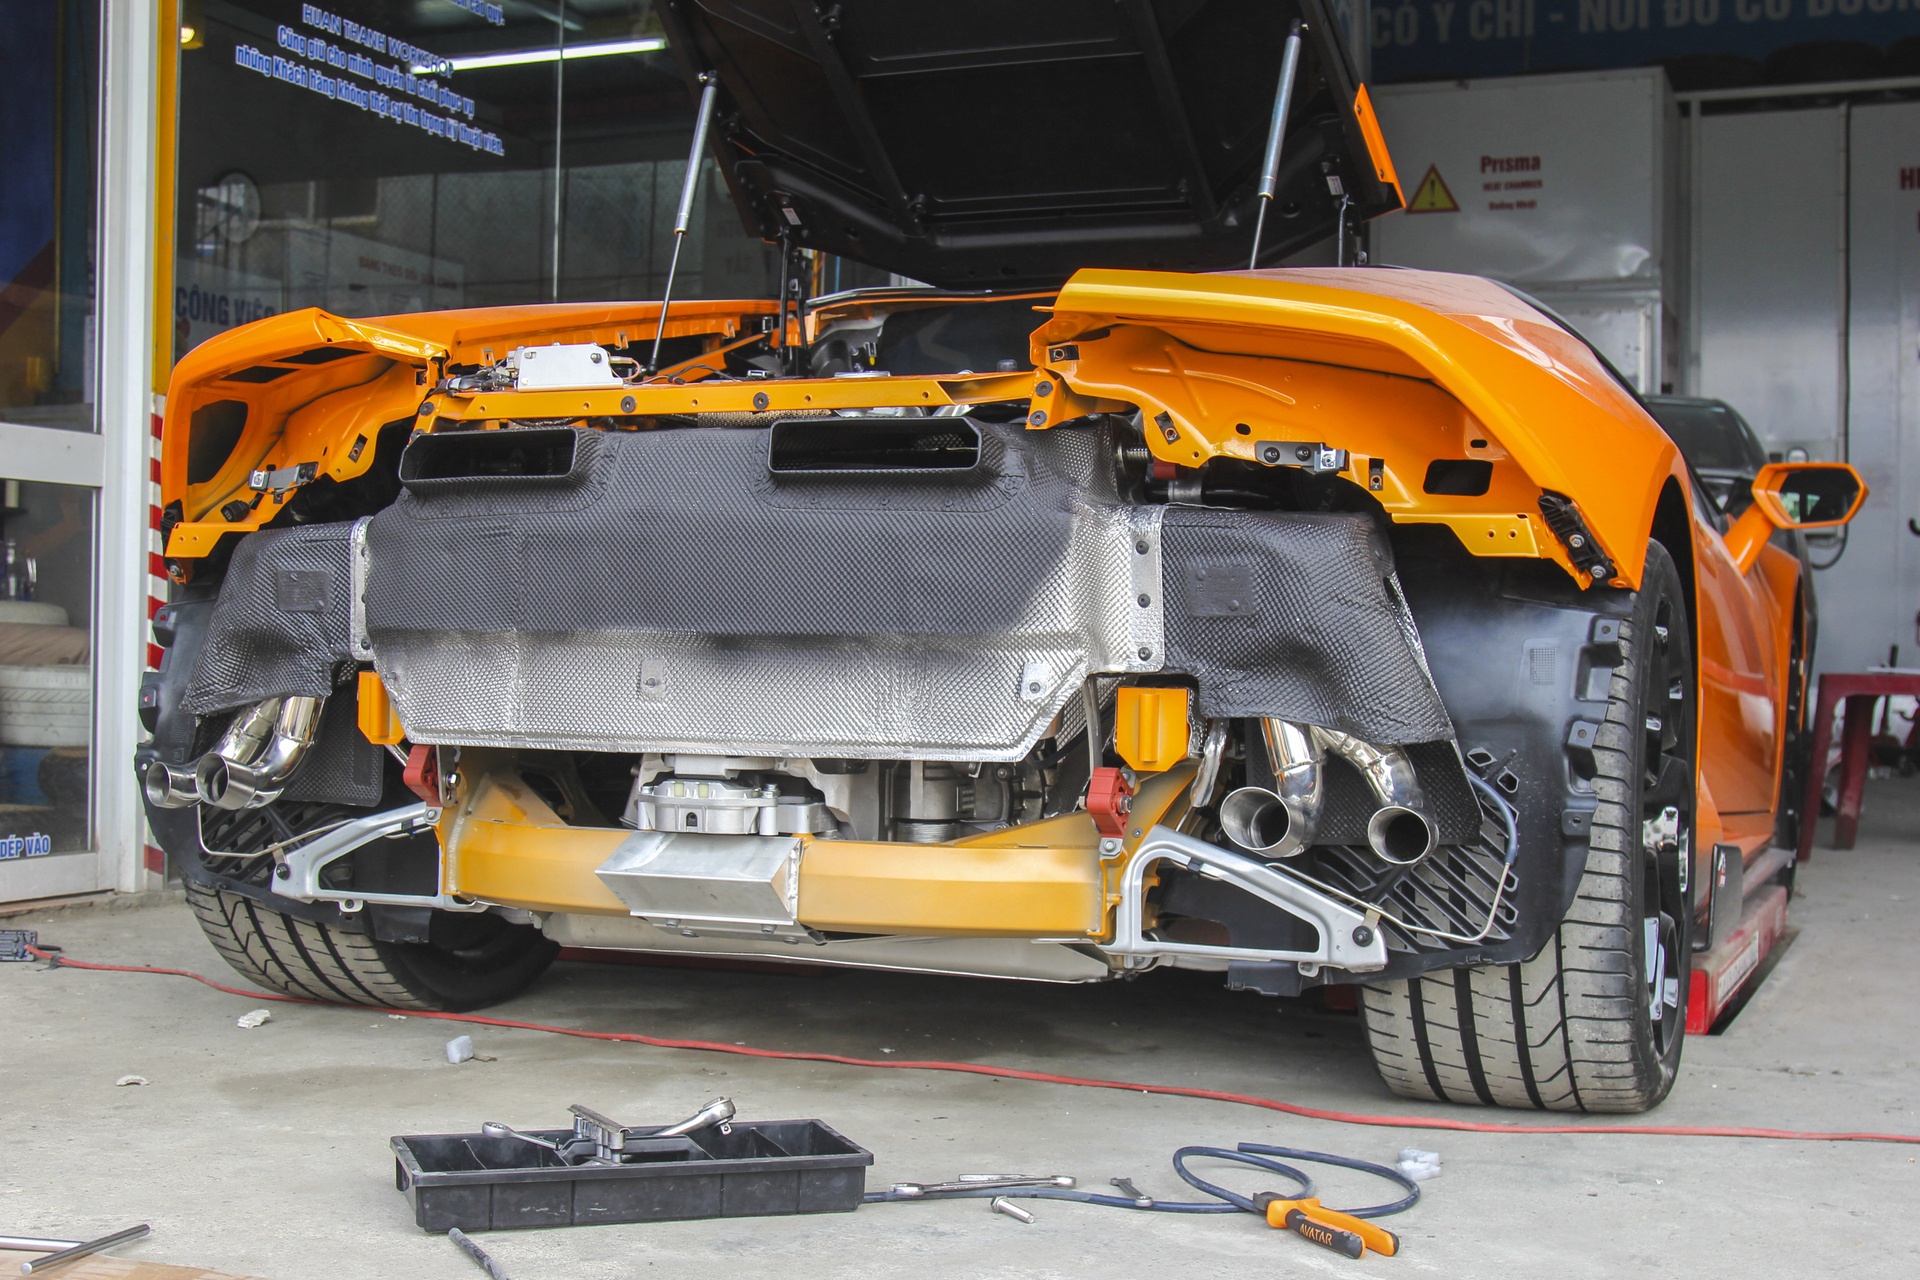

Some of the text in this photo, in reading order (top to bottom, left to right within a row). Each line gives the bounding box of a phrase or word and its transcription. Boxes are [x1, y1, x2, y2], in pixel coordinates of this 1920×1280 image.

[303, 3, 454, 78] HUAN THANH WORKSHOP
[278, 24, 307, 57] Cũng
[308, 37, 327, 62] giữ
[327, 44, 347, 69] cho
[347, 53, 374, 80] mình
[375, 64, 405, 91] quyền
[438, 87, 462, 113] phục
[463, 97, 475, 120] vụ
[235, 44, 272, 77] những
[272, 55, 308, 88] Khách
[308, 68, 336, 99] hàng
[336, 78, 369, 110] không
[369, 90, 390, 118] thật
[390, 100, 403, 124] sự
[403, 102, 420, 127] tôn
[420, 108, 446, 137] trọng
[459, 122, 483, 151] thuật
[1481, 155, 1541, 174] Prisma
[176, 284, 230, 326] CÔNG
[25, 832, 51, 857] VÀO
[1300, 1223, 1333, 1246] AVATAR
